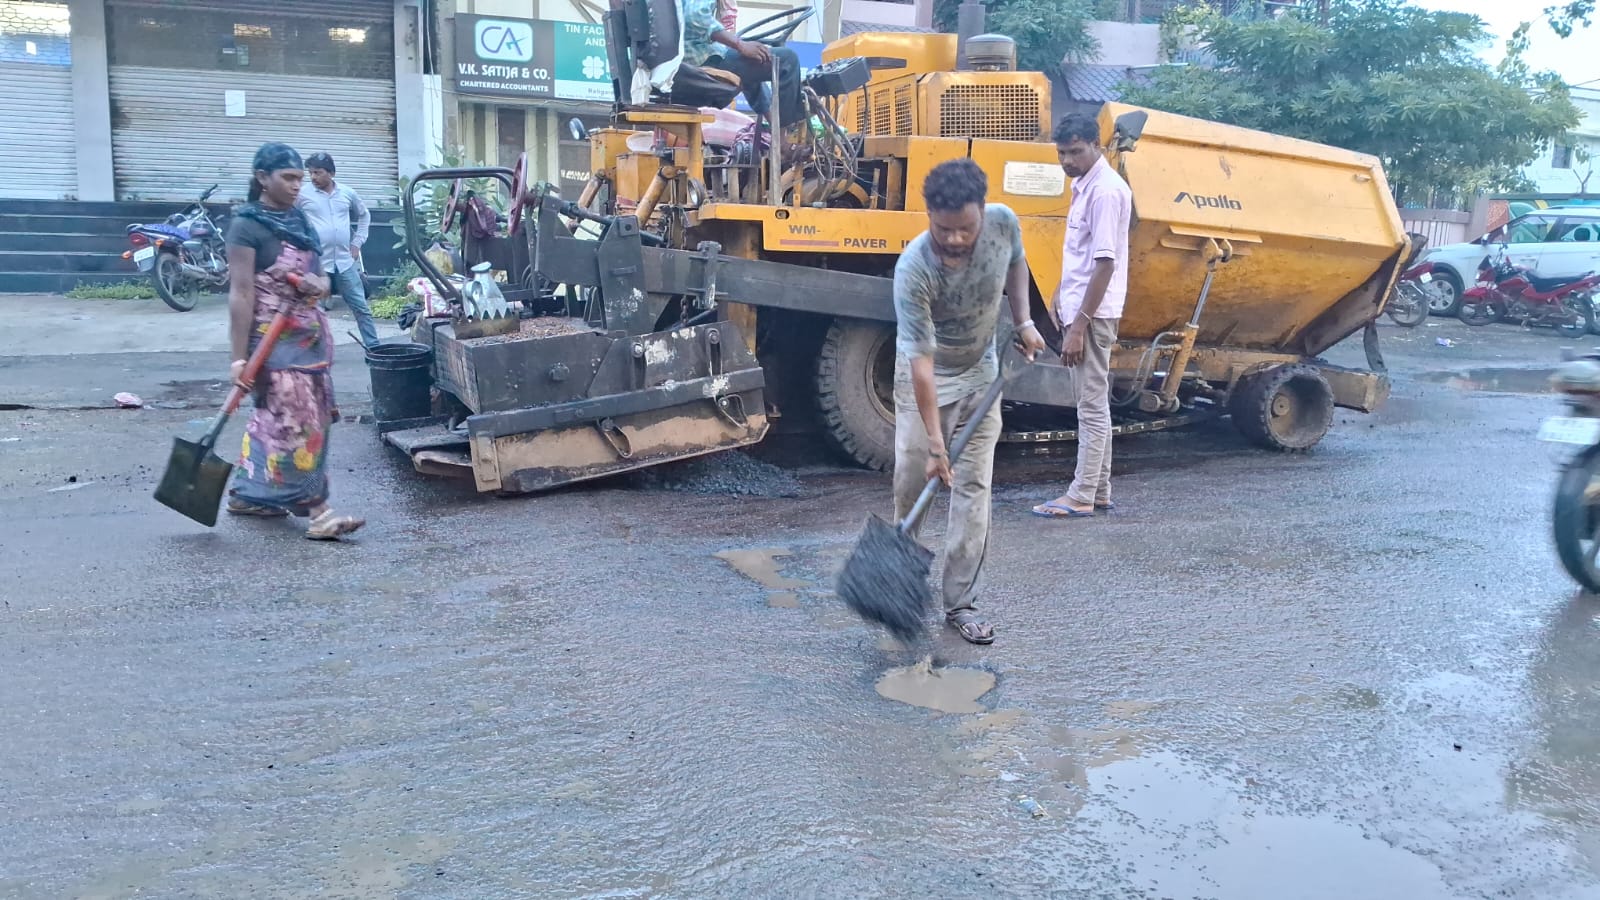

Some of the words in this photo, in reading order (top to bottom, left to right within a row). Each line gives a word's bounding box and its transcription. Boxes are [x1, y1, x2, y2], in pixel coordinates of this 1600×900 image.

[564, 23, 580, 34] TIN
[481, 26, 523, 56] CA
[584, 37, 606, 47] AND
[458, 63, 479, 75] V.K.
[482, 64, 519, 80] SATIJA
[521, 67, 530, 79] &
[533, 68, 551, 80] CO.
[460, 80, 500, 89] CHARTERED
[501, 83, 549, 92] ACCOUNTANTS
[1173, 191, 1242, 211] Apollo
[843, 237, 887, 249] PAVER
